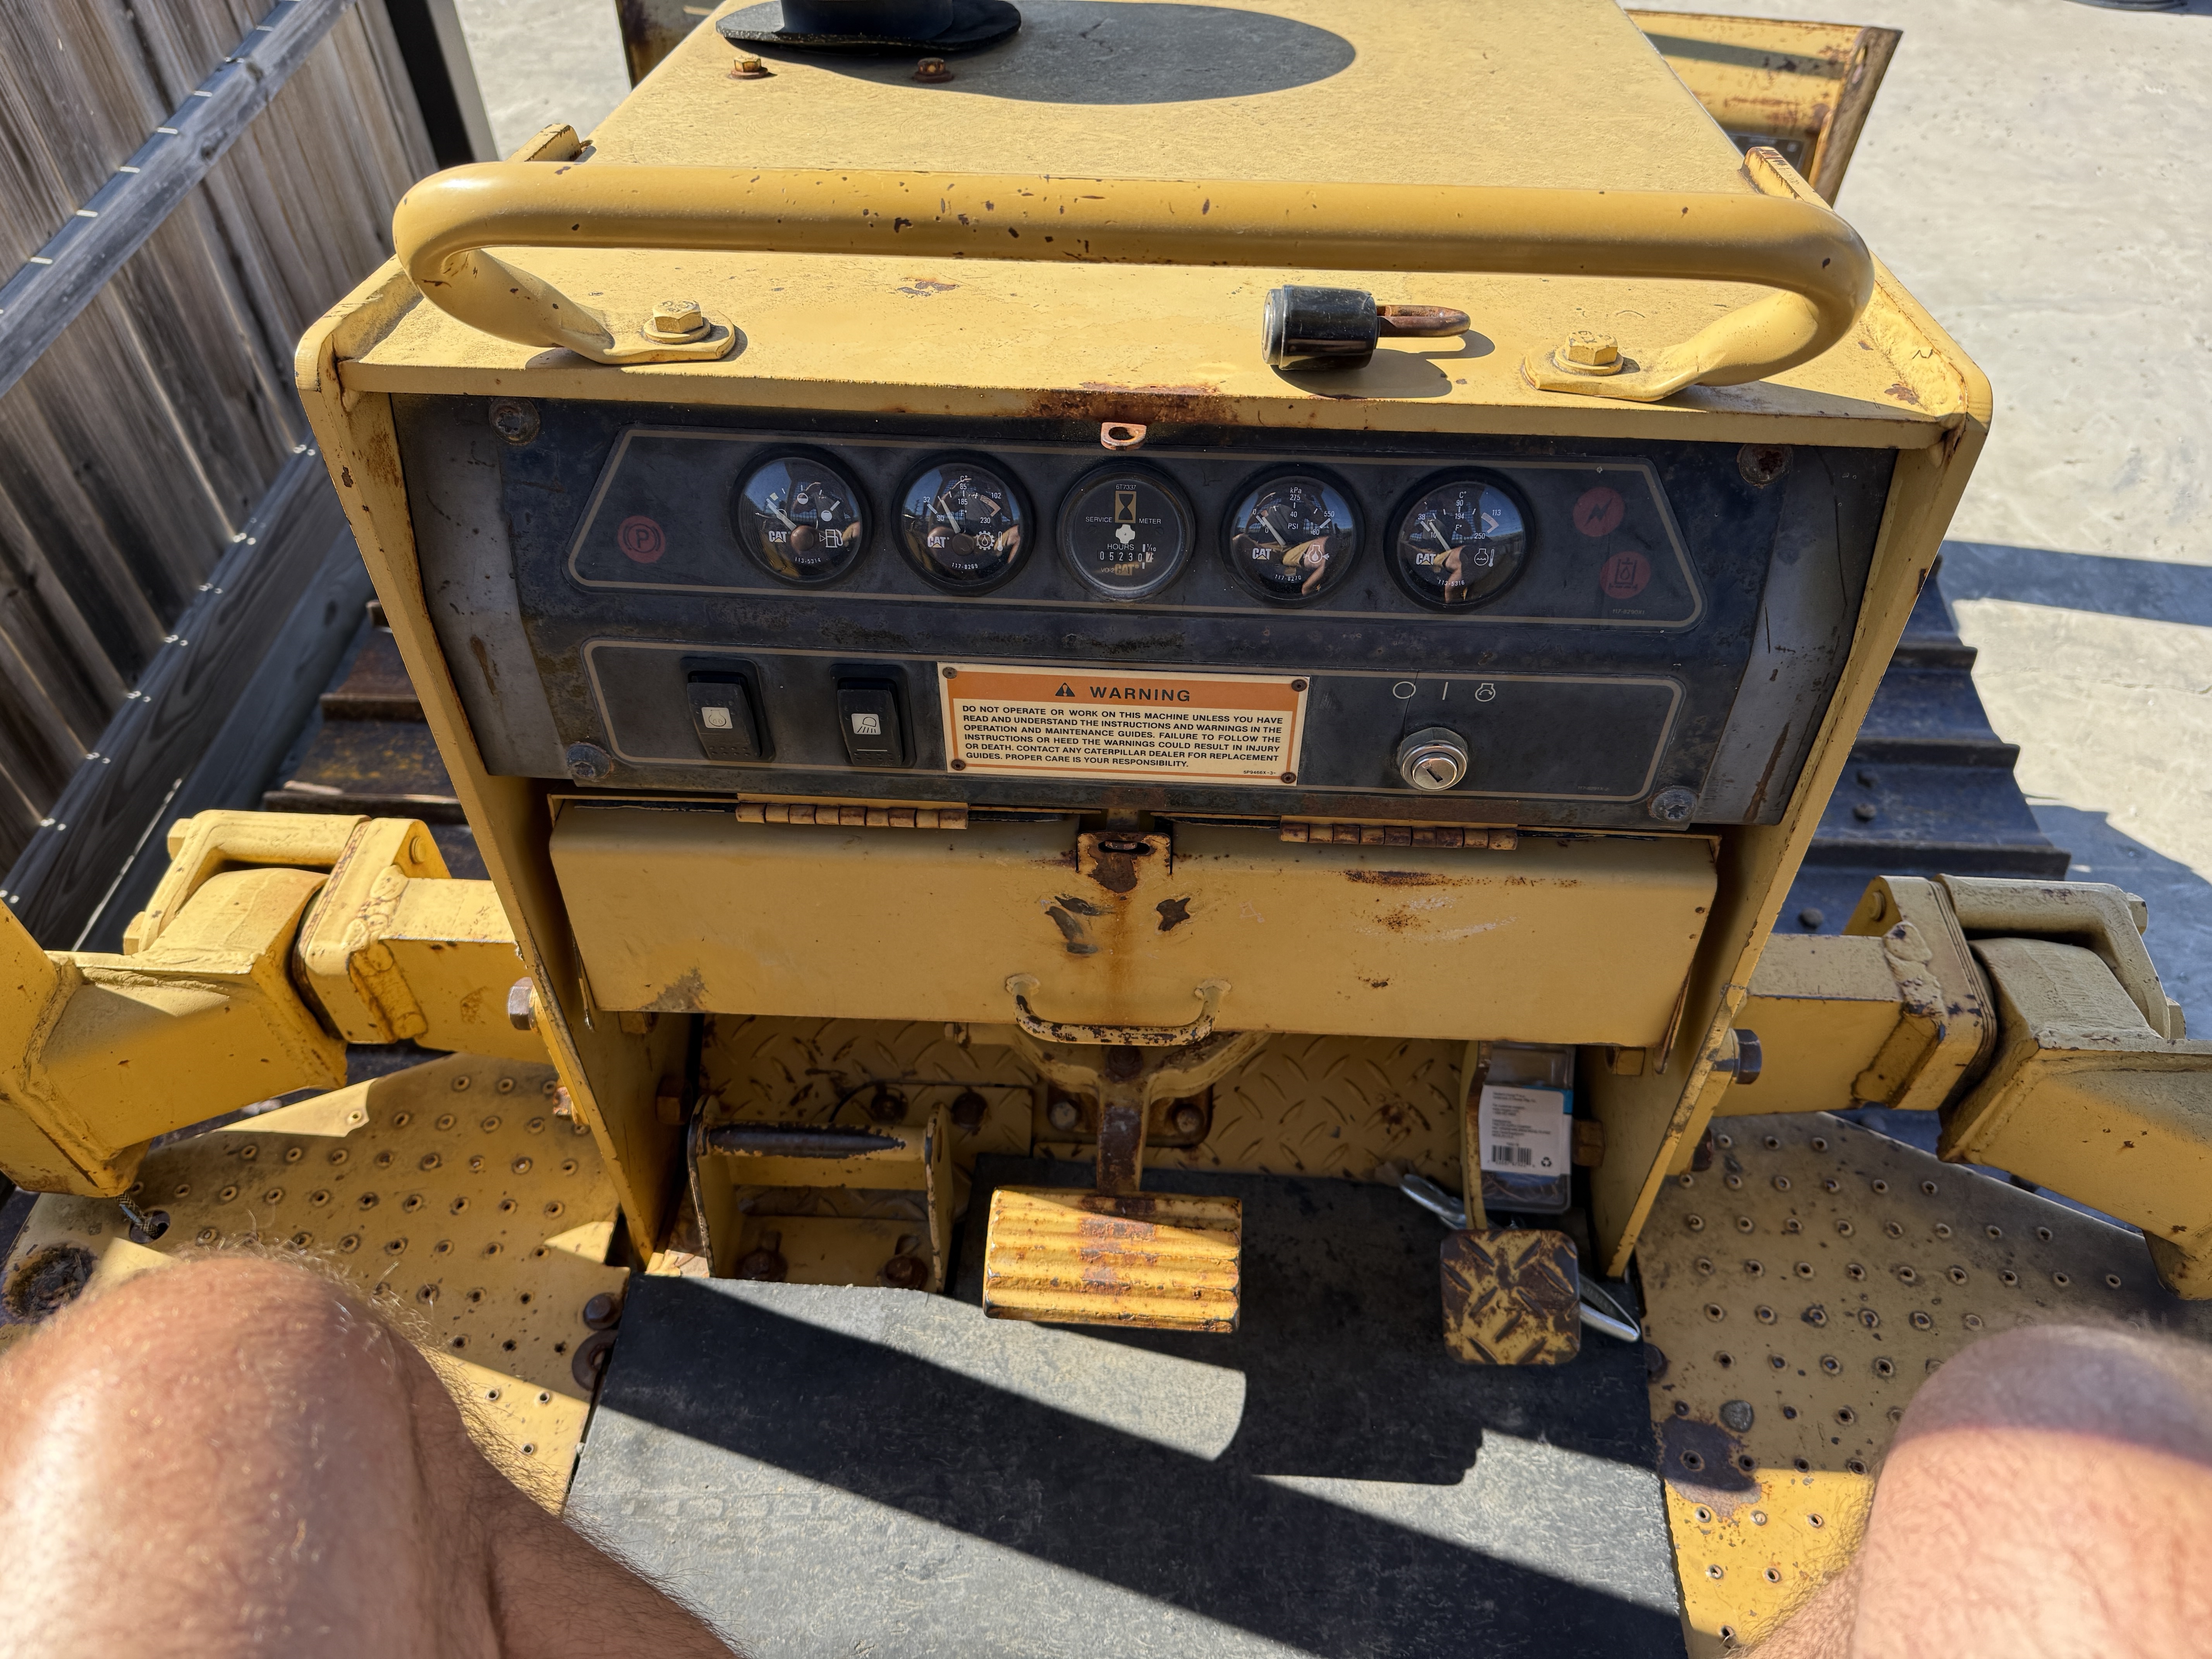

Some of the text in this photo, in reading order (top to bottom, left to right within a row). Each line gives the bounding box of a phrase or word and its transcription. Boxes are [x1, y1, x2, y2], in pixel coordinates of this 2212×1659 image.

[769, 531, 787, 543] CAT
[927, 536, 946, 548] CAT
[1252, 548, 1271, 560] CAT
[1416, 553, 1436, 565] CAT
[1090, 686, 1190, 702] WARNING
[1144, 713, 1189, 721] MACHINE
[1014, 717, 1078, 725] UNDERSTAND
[1101, 720, 1171, 729] INSTRUCTIONS
[1196, 724, 1248, 732] WARNINGS
[1045, 728, 1114, 737] MAINTENANCE
[965, 734, 1033, 742] INSTRUCTIONS
[1104, 739, 1155, 747] WARNINGS
[1084, 748, 1146, 756] CATERPILLAR
[1210, 753, 1279, 761] REPLACEMENT
[1112, 758, 1188, 767] RESPONSIBILITY.
